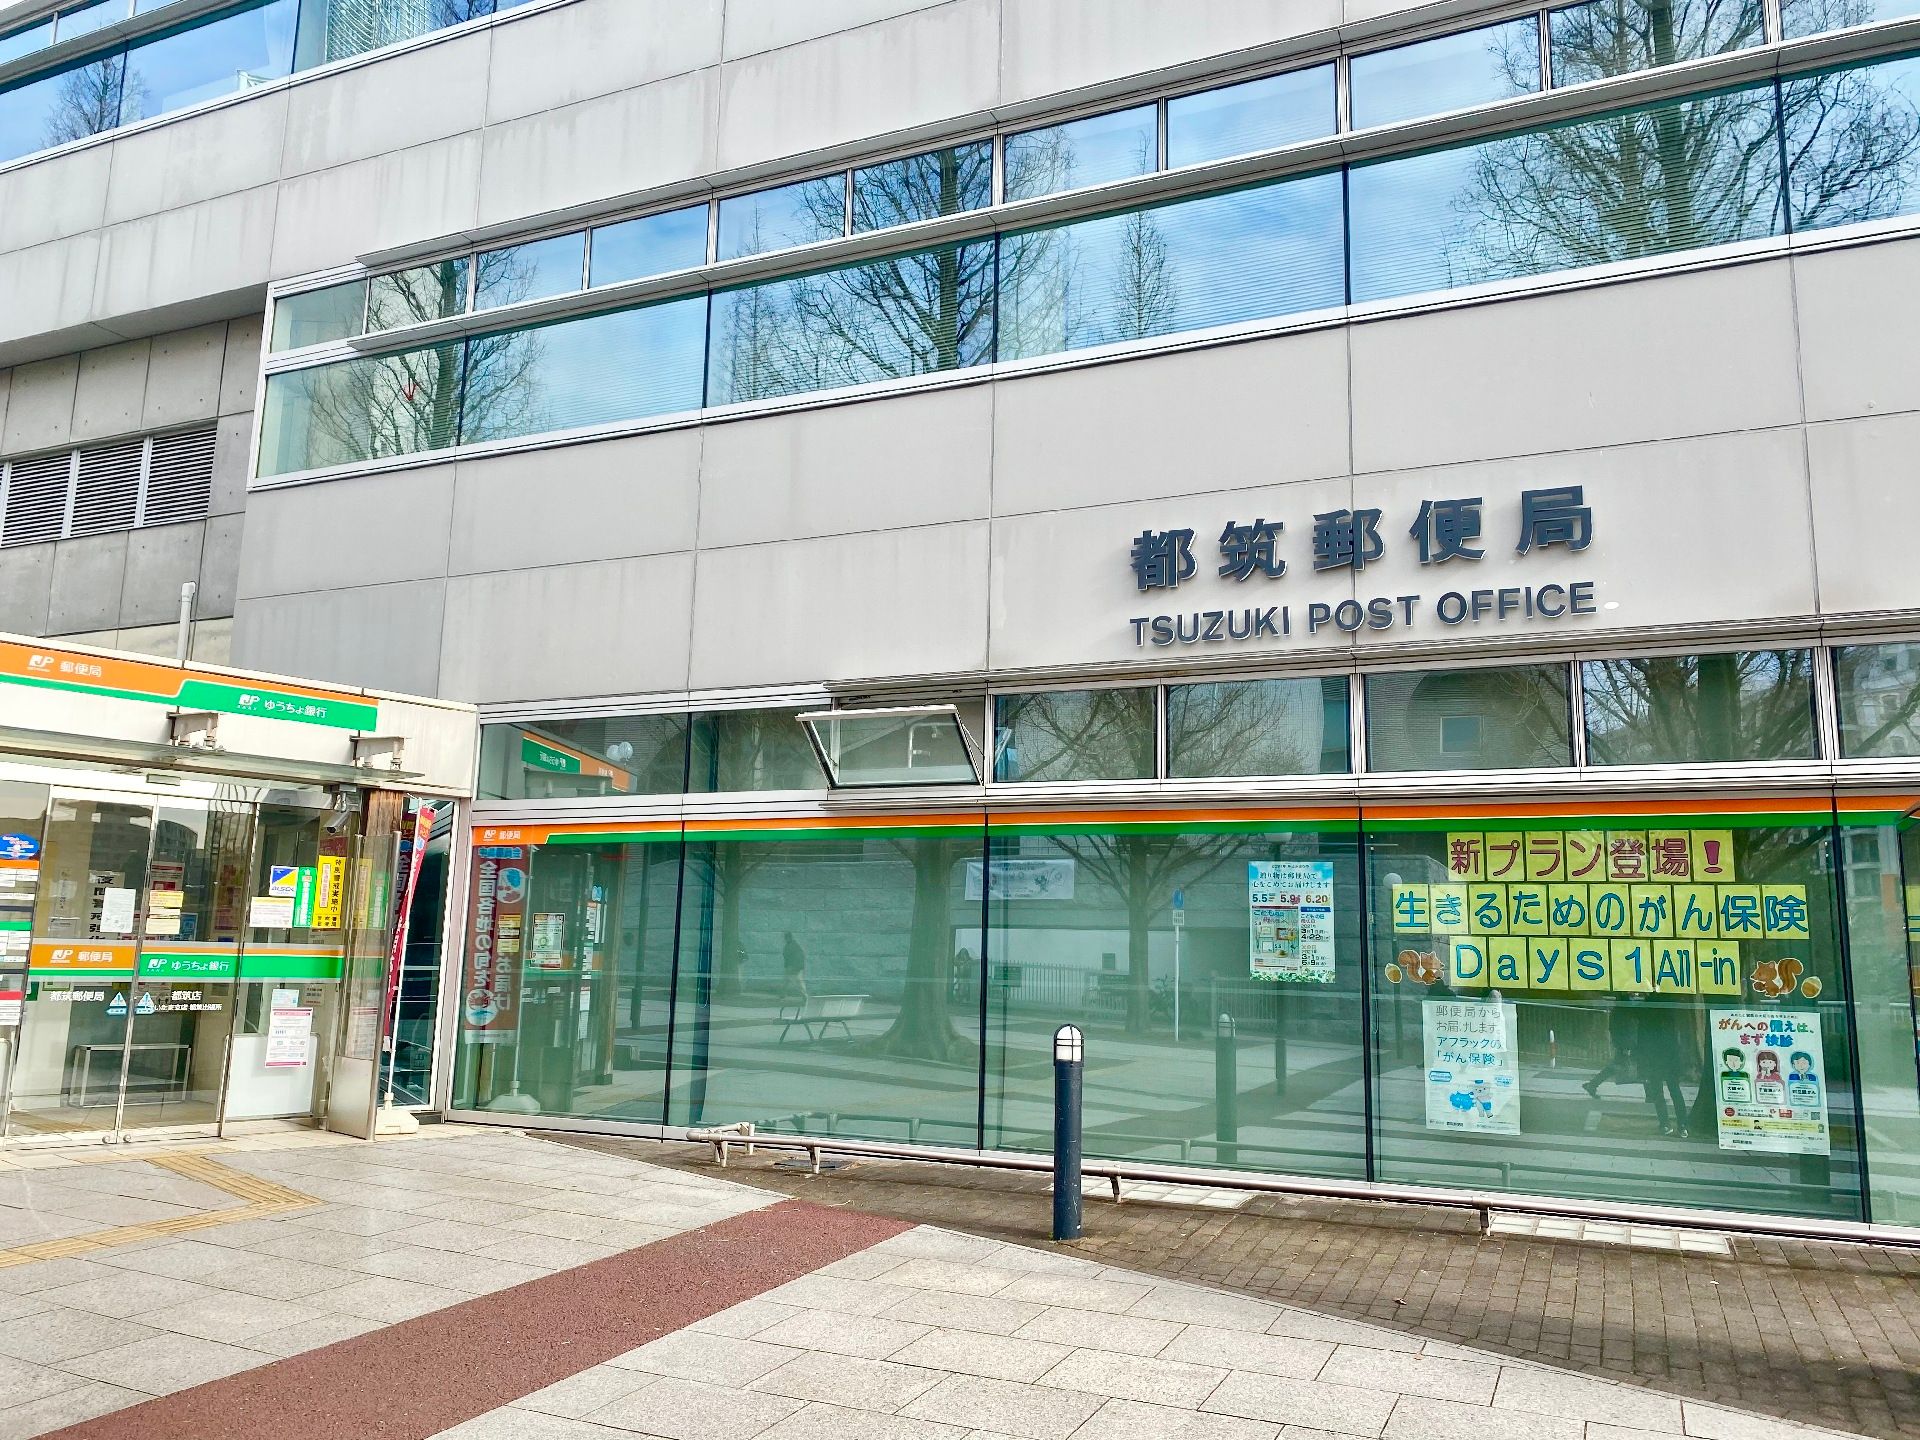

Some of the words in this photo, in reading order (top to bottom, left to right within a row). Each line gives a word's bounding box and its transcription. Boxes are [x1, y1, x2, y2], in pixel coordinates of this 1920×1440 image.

[1130, 485, 1593, 591] 都筑郵便局
[1129, 605, 1291, 647] TSUZUKI
[1309, 595, 1422, 634] POST
[1436, 581, 1598, 626] OFFICE
[59, 661, 102, 678] 郵便局
[264, 700, 328, 718] ゆうちょ銀行
[499, 830, 521, 840] 郵便局
[1450, 837, 1724, 881] 新プラン登場！
[1252, 894, 1268, 903] 5.5
[1280, 894, 1296, 903] 5.9
[1305, 894, 1328, 903] 6.20
[1394, 889, 1809, 934] 生きるためのがん保険
[77, 951, 113, 962] 郵便局
[171, 960, 230, 972] ゆうちょ銀行
[50, 990, 105, 1002] 都筑郵便局
[171, 990, 203, 1001] 都筑店
[1435, 1004, 1501, 1018] 郵便局から
[1436, 1020, 1501, 1035] お届けします。
[1718, 1018, 1815, 1034] がんへの備えは、
[1436, 1036, 1502, 1050] アフラックの
[1739, 1033, 1795, 1048] まず検診
[1437, 1050, 1503, 1067] 「がん保険」
